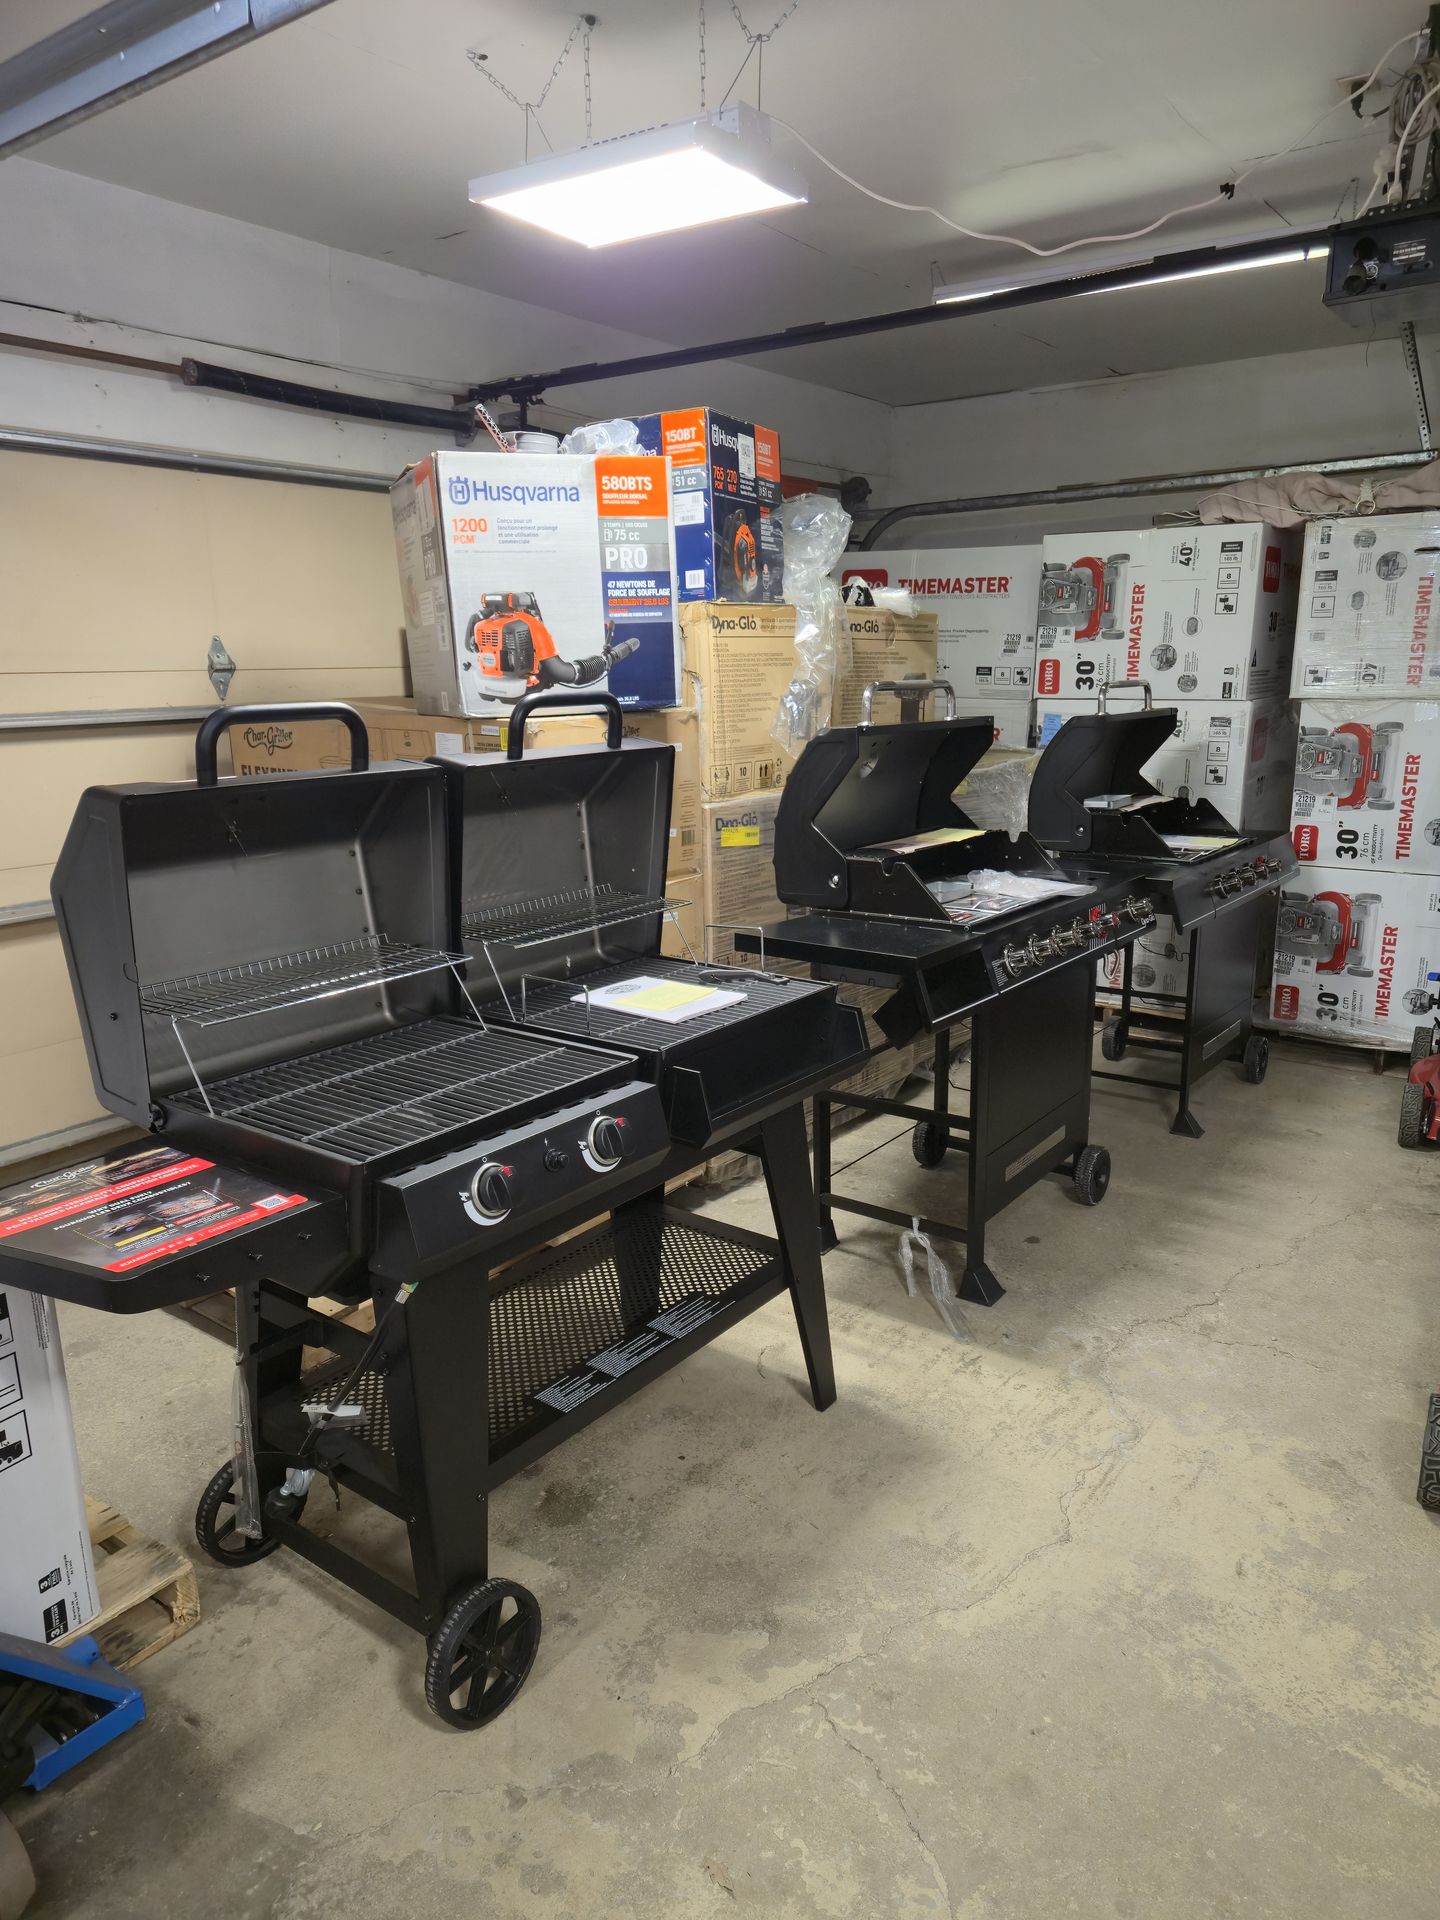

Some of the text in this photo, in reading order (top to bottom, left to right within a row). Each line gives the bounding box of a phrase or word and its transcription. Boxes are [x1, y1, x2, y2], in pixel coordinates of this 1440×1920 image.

[665, 427, 697, 443] 150BT
[718, 429, 739, 452] Husq
[675, 476, 697, 486] 51 cc
[713, 465, 724, 481] 765
[727, 469, 738, 483] 270
[602, 475, 653, 491] 580BTS
[472, 480, 580, 505] Husqvarna
[452, 518, 488, 533] 1200
[614, 529, 640, 541] 75 cc
[605, 547, 648, 569] PRO
[616, 580, 647, 588] NEWTONS
[648, 580, 655, 588] DE
[898, 576, 1010, 595] TIMEMASTER
[607, 588, 671, 597] FORCE DE SOUFFLAGE
[712, 614, 758, 634] Dyna-Glo
[849, 618, 879, 634] na-Glo
[1042, 627, 1058, 635] 21219
[1126, 582, 1146, 681] IMEMASTER
[1407, 576, 1434, 687] TIMEMASTER
[1006, 633, 1021, 641] 21219
[1044, 661, 1054, 692] TORO
[1097, 662, 1104, 676] cm
[243, 726, 294, 756] Char-Griller
[739, 767, 747, 777] 10
[1297, 795, 1316, 803] 21219
[1396, 753, 1421, 860] TIMEMASTER
[1299, 827, 1311, 861] TORO
[1360, 832, 1370, 858] 76 cm
[1278, 952, 1296, 961] 21219
[1280, 987, 1291, 1018] TORO
[1343, 996, 1350, 1010] cm
[40, 1581, 48, 1590] 3
[51, 1628, 60, 1638] 3
